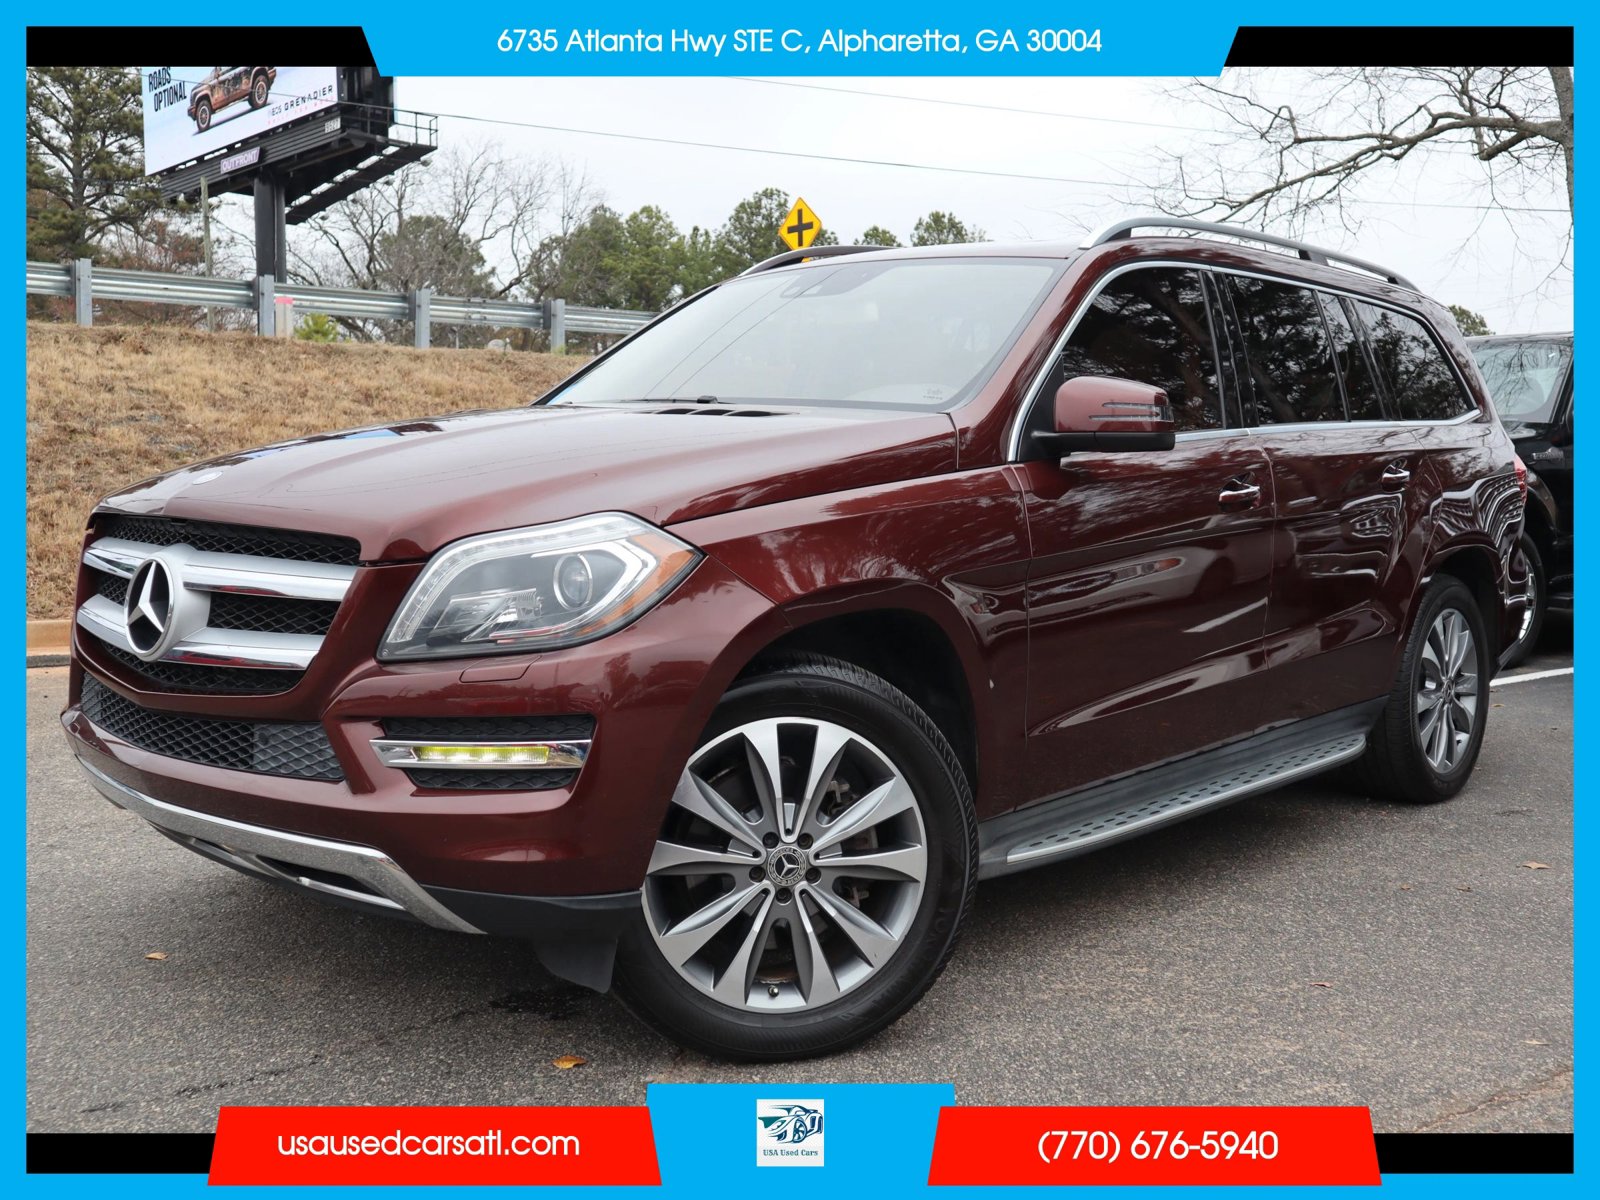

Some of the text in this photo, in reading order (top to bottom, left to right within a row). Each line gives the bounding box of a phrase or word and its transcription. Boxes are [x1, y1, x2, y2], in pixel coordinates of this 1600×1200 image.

[149, 66, 171, 92] ROADS
[154, 81, 187, 112] OPTIONAL
[284, 85, 333, 111] GRENADIER
